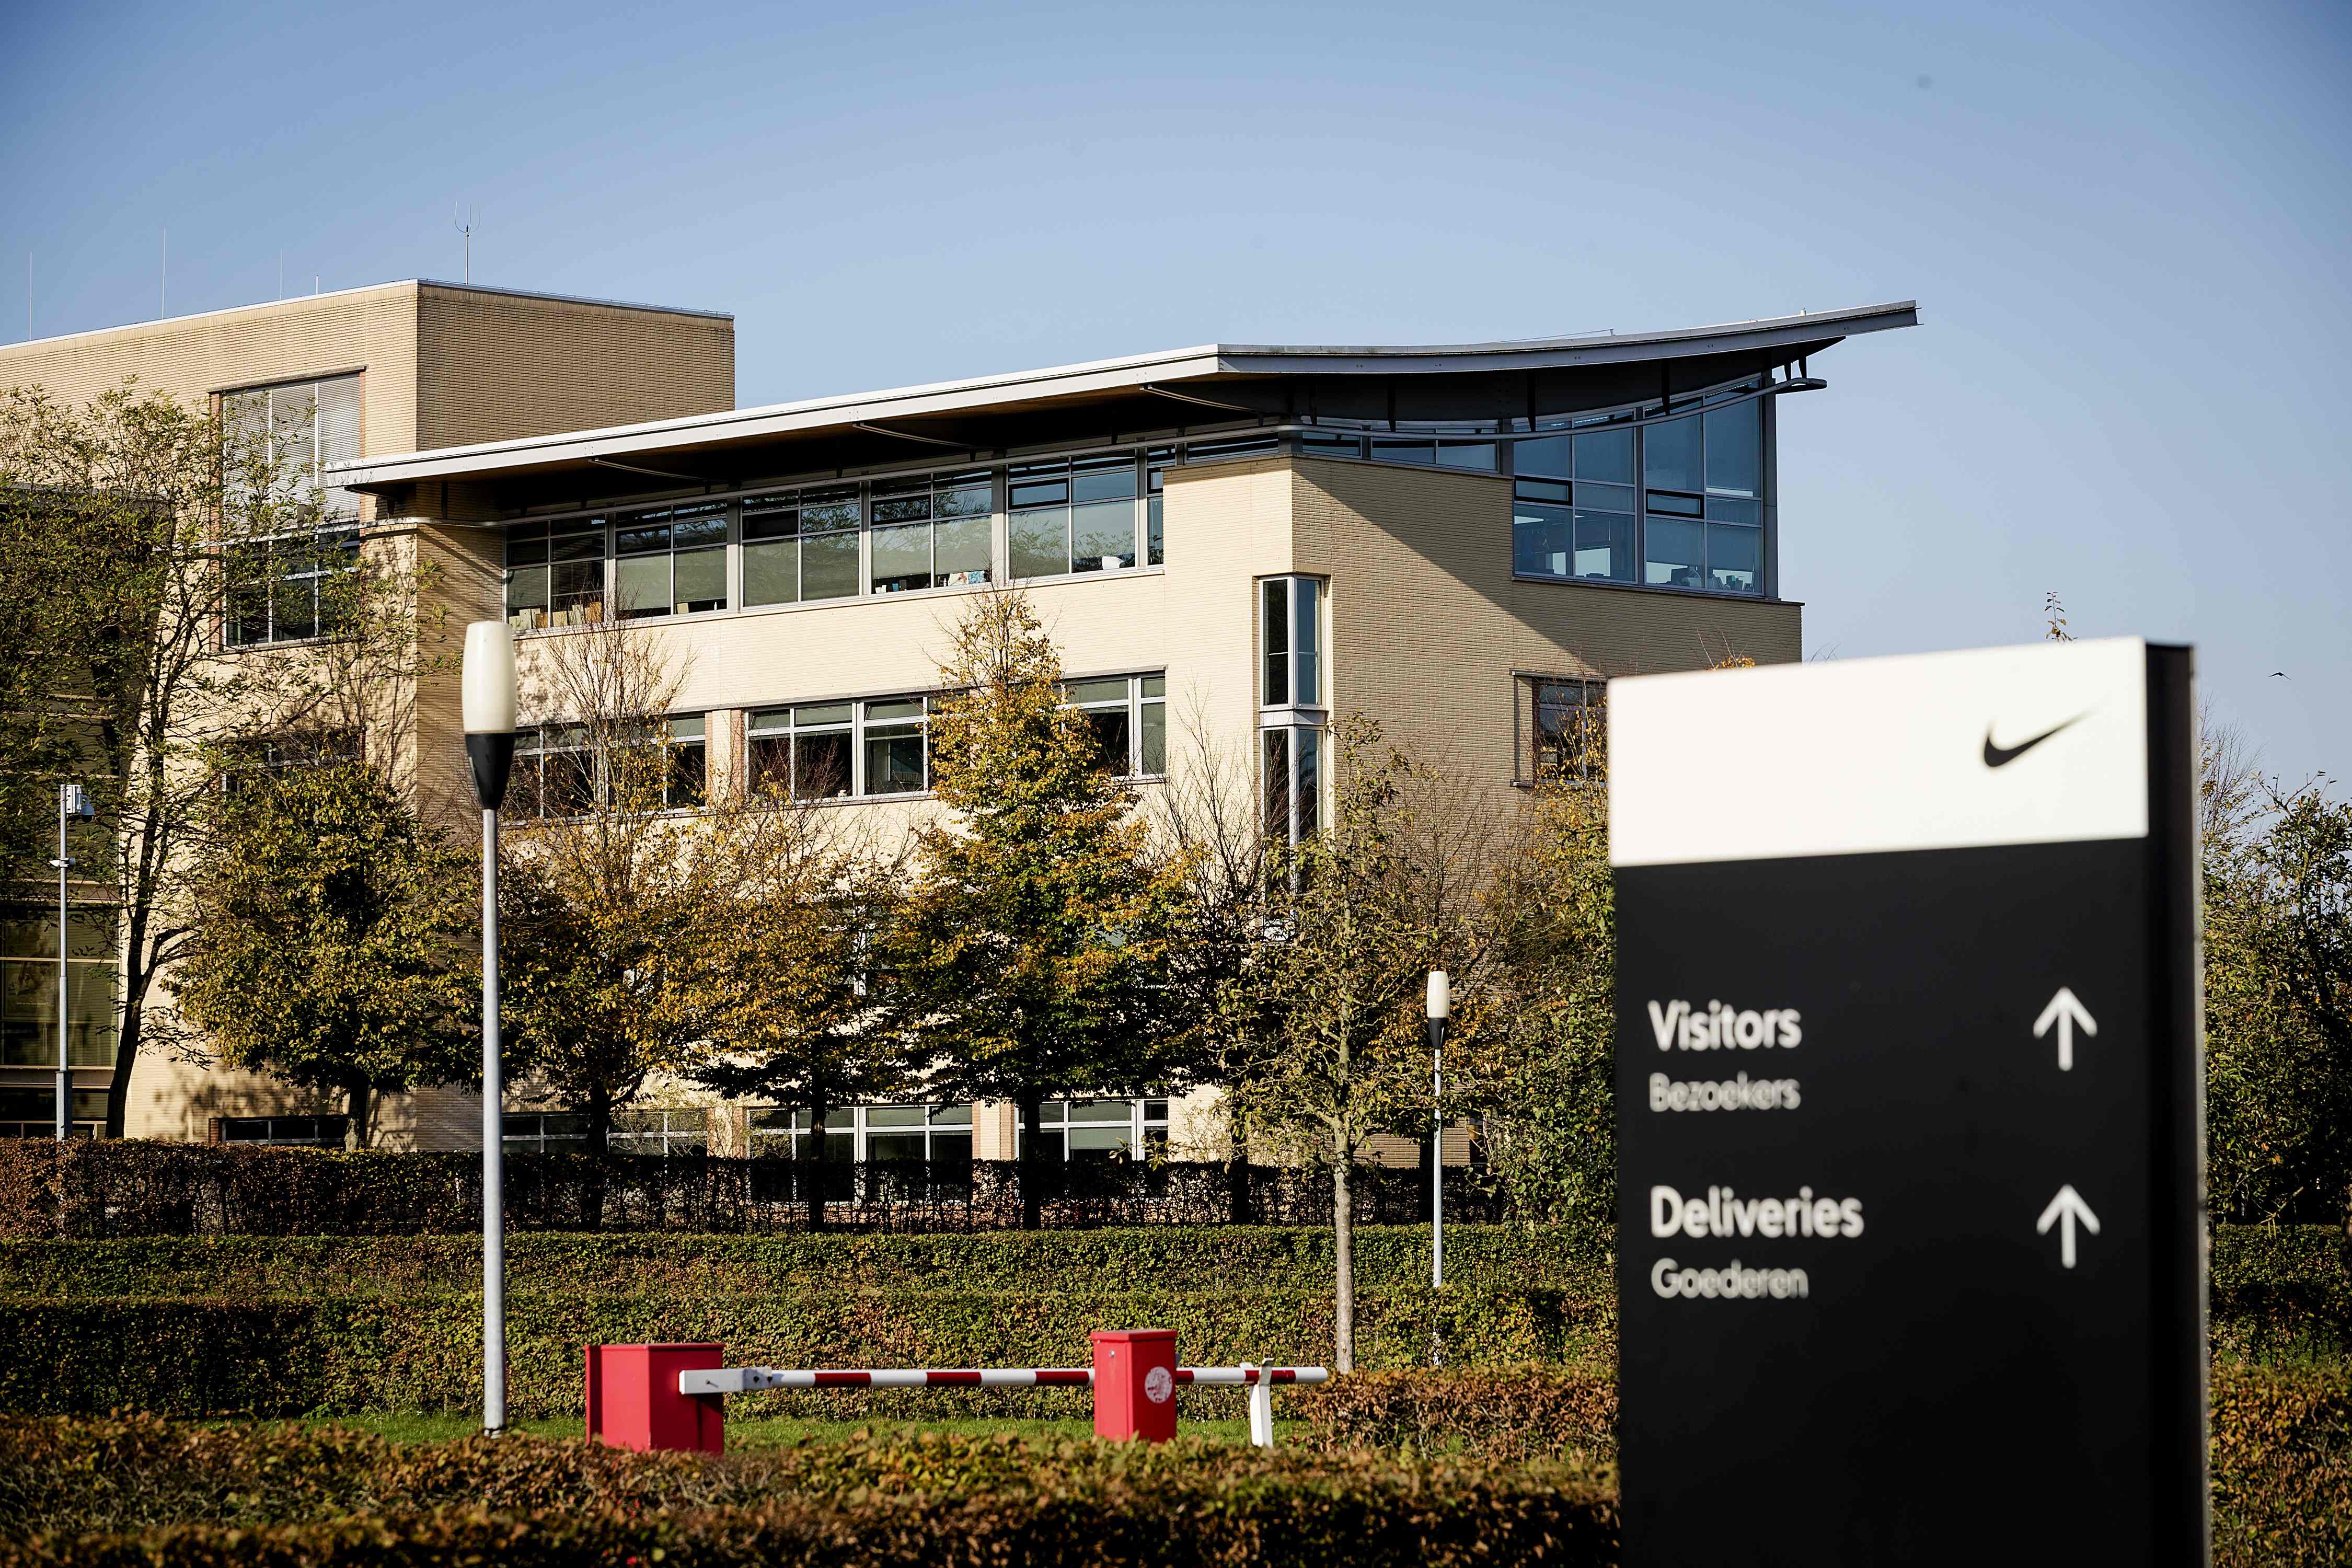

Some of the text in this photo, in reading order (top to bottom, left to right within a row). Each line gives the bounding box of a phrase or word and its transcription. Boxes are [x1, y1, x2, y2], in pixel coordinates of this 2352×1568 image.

[1648, 999, 1803, 1052] Visitors
[1649, 1070, 1801, 1112] Bezoekers
[1651, 1185, 1864, 1239] Deliveries
[1651, 1258, 1809, 1299] Goederen
